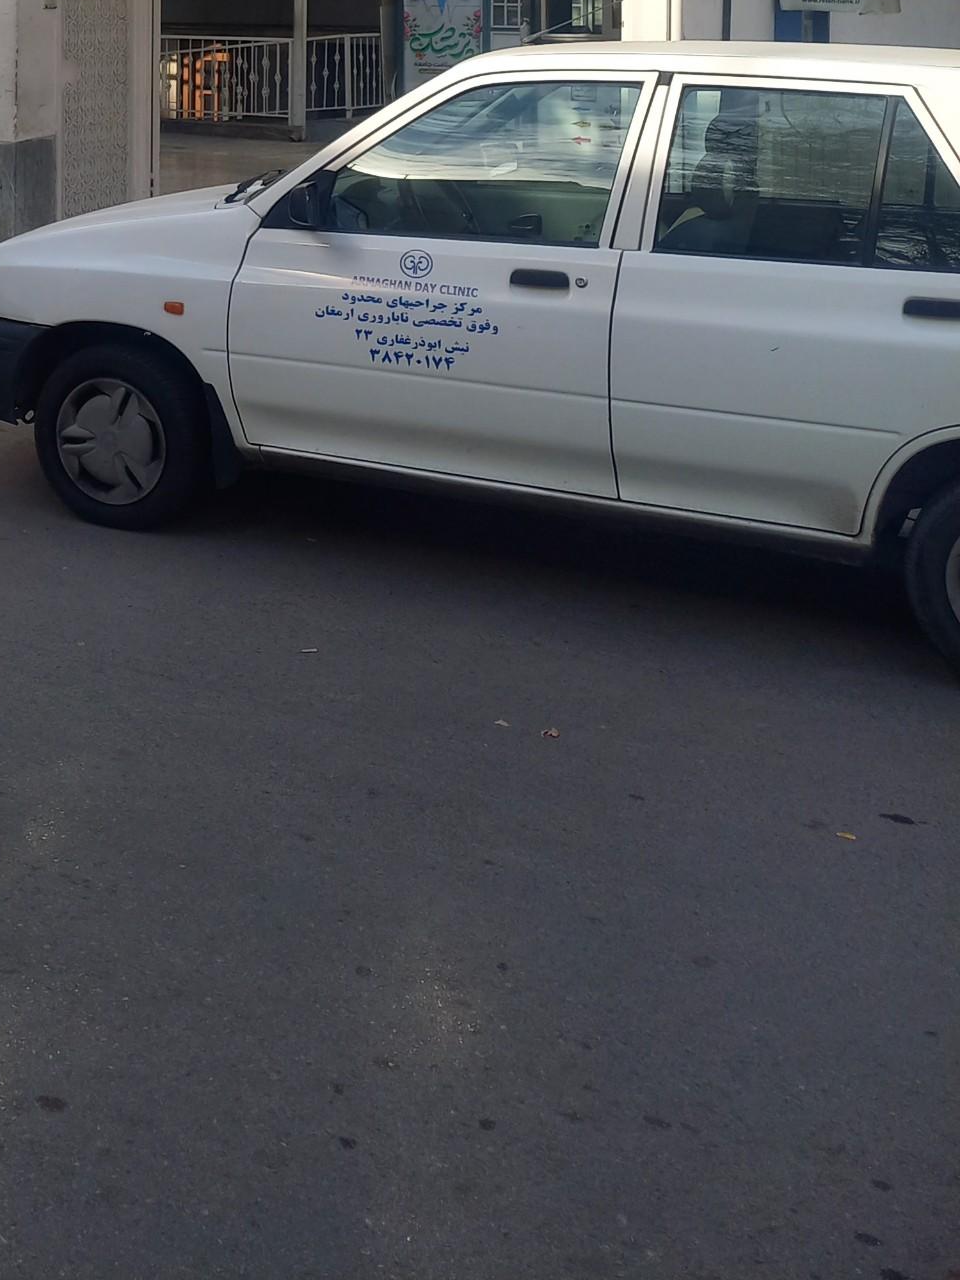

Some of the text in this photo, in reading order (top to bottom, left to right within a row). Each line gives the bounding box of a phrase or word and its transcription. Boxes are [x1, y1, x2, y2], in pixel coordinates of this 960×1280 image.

[414, 282, 436, 294] DAY
[439, 284, 479, 298] CLINIC
[314, 304, 354, 320] ارمغان
[341, 292, 483, 317] مرکز جراحیهای محدود
[357, 309, 409, 325] ناباروری
[412, 315, 463, 329] تخصصی
[444, 340, 470, 355] نبش
[369, 348, 456, 371] ۳۸۴۲۰۱۷۴
